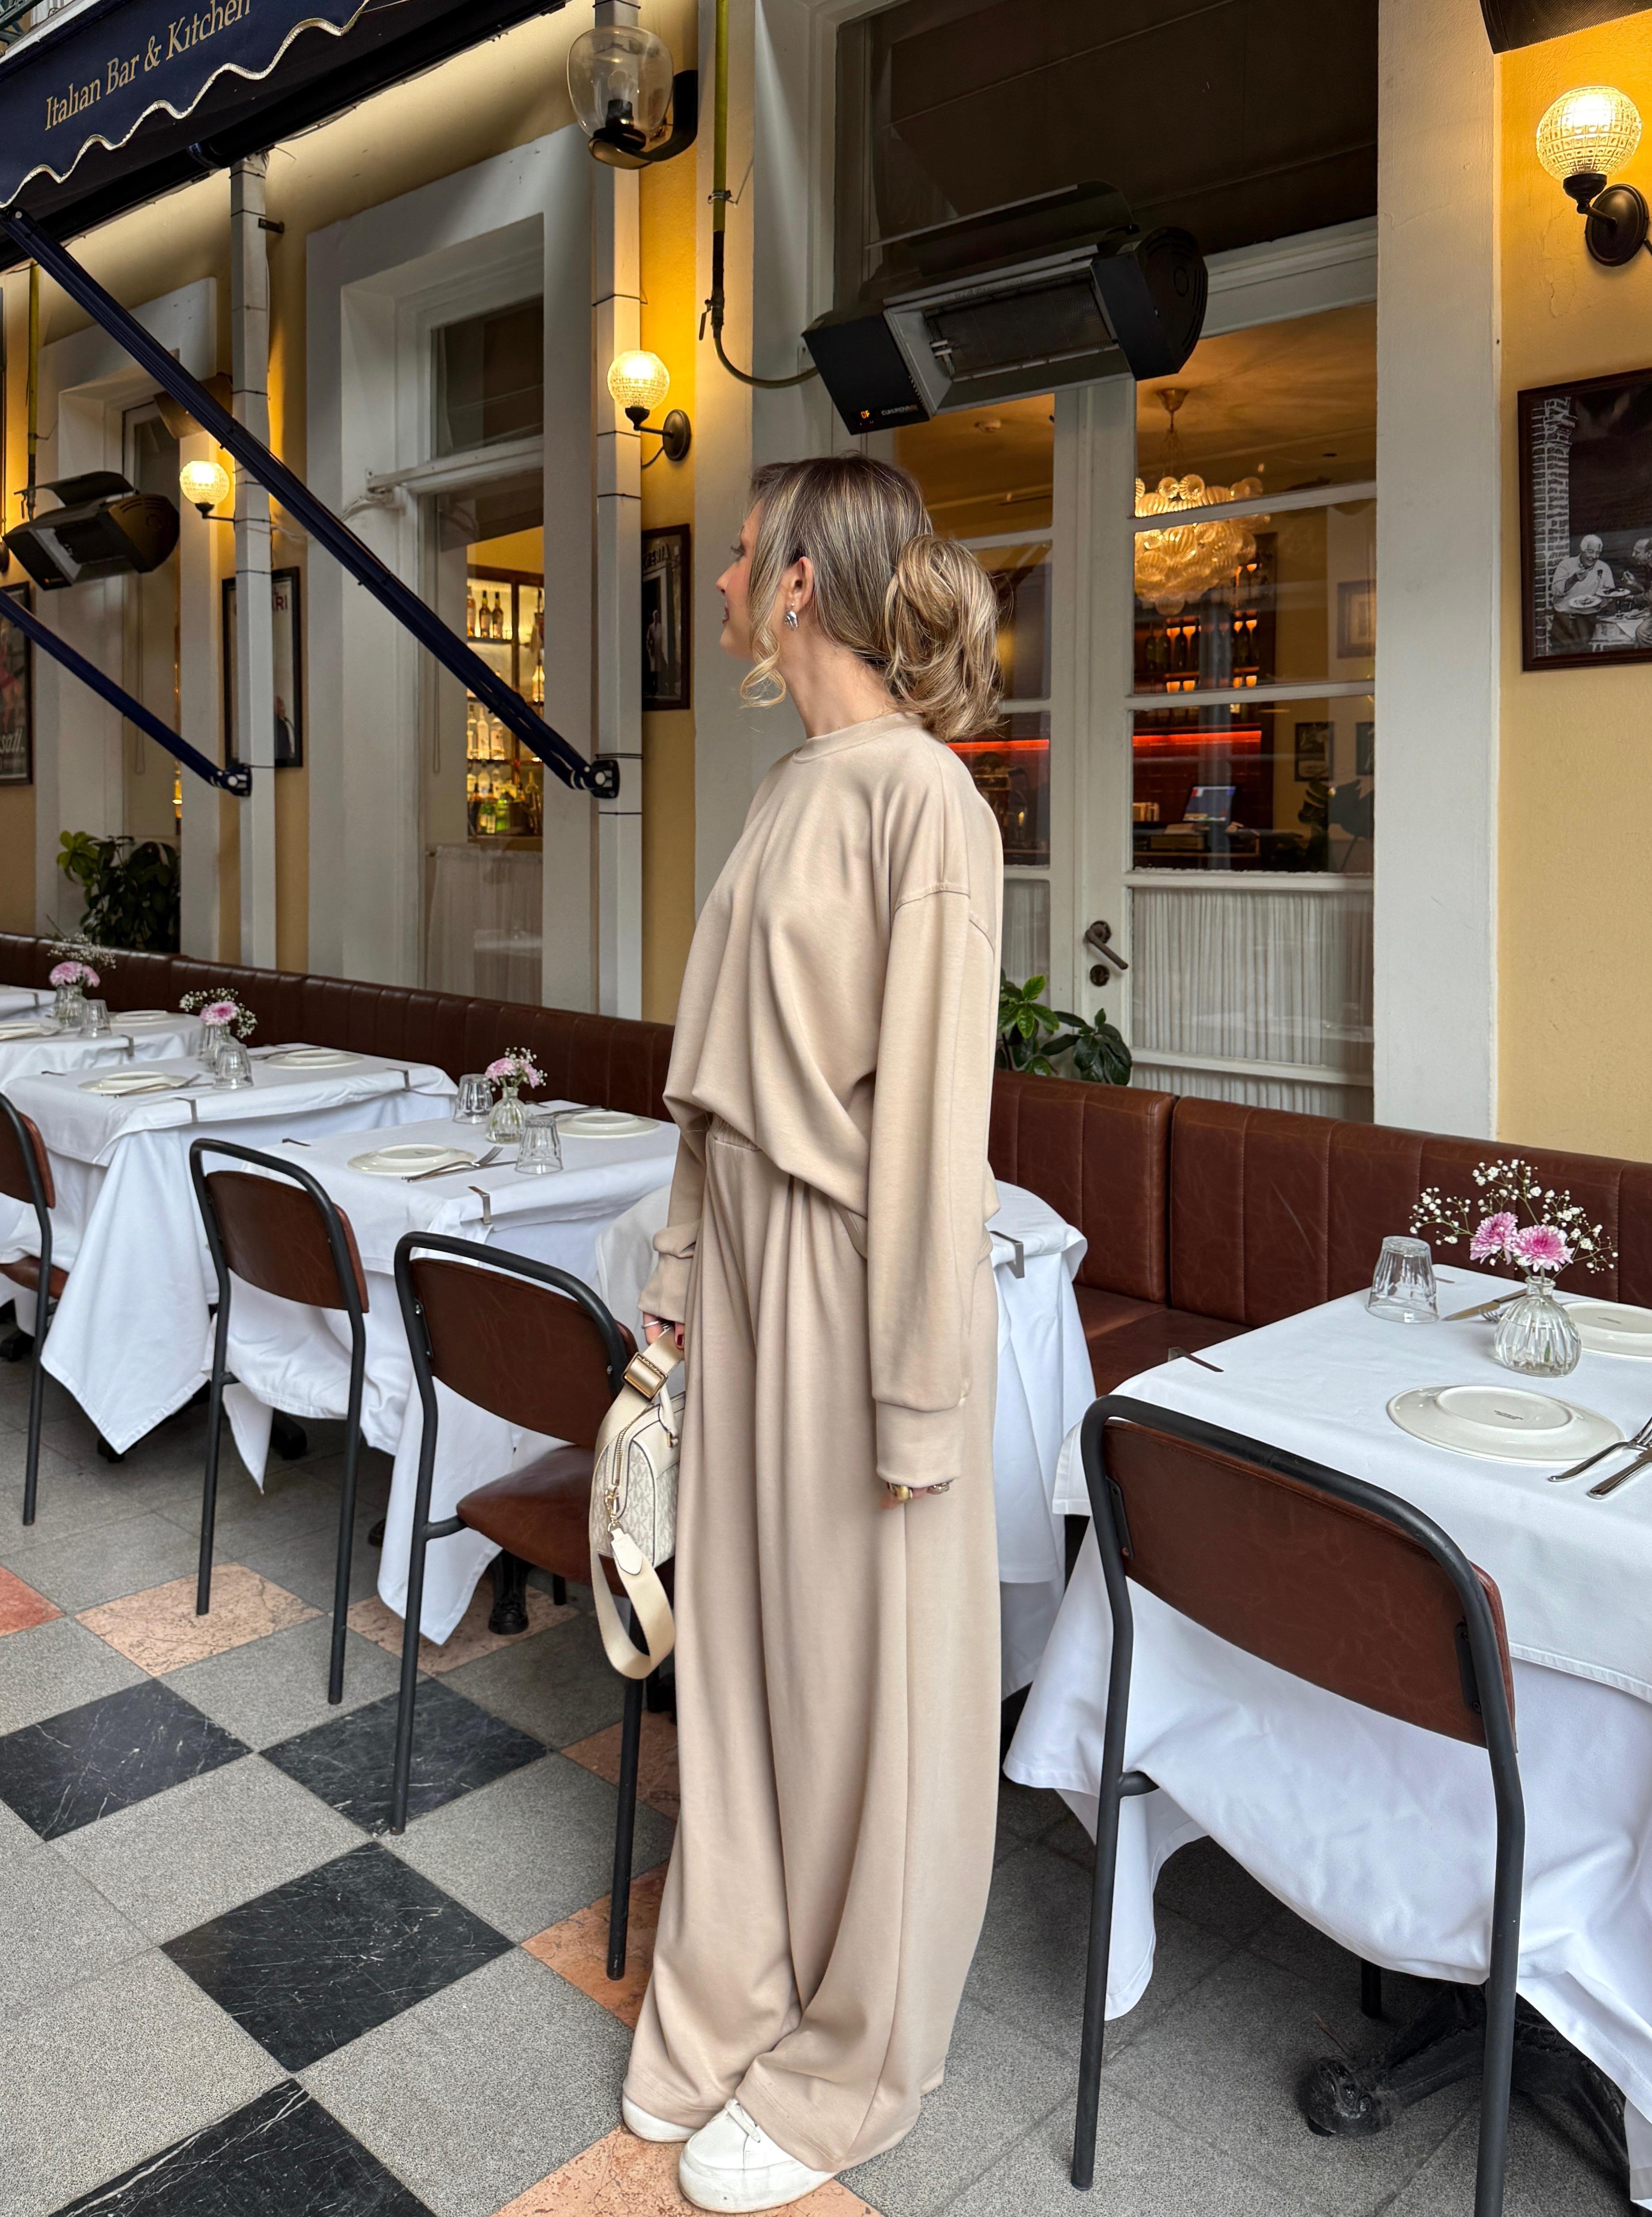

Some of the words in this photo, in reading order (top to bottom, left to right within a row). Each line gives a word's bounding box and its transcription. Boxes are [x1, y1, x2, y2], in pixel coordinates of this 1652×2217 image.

[45, 79, 100, 130] Italian
[106, 54, 140, 95] Bar
[144, 35, 161, 72] &
